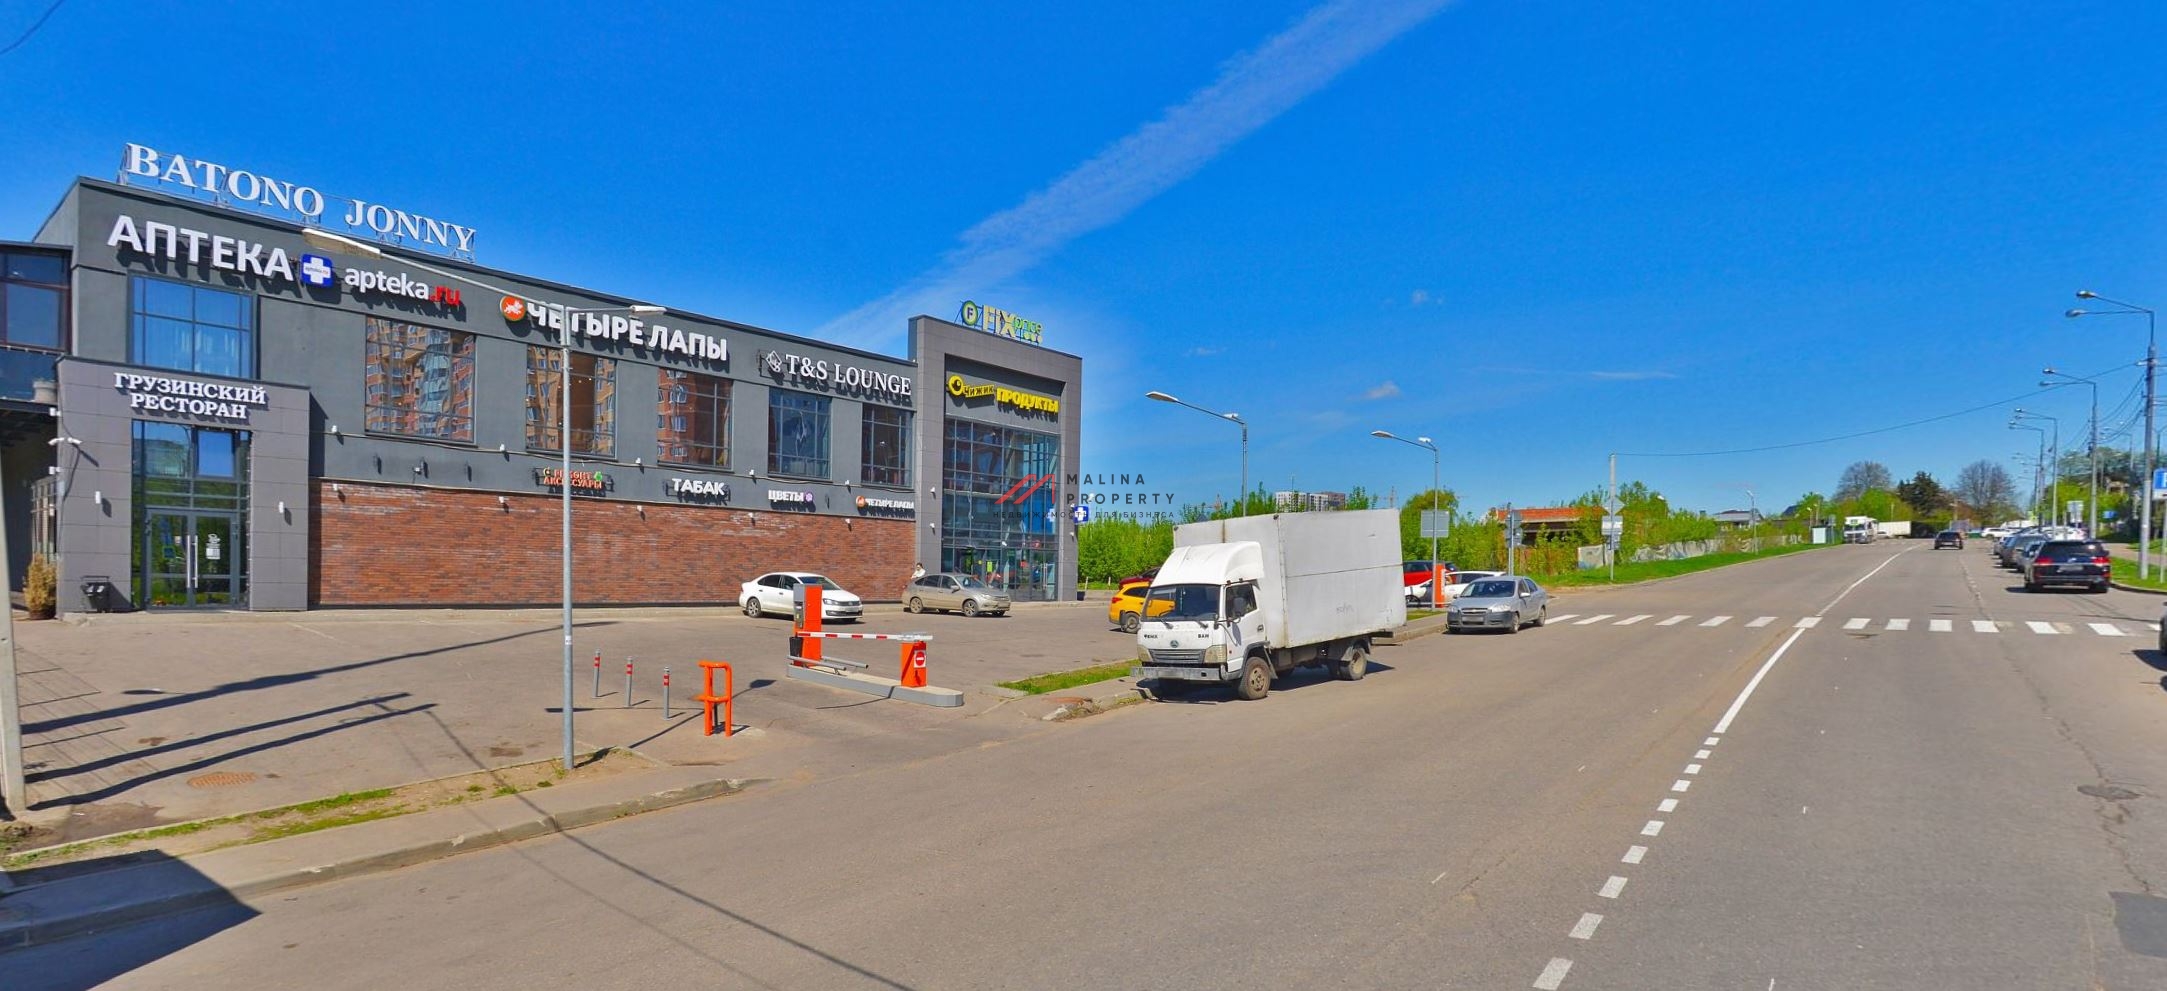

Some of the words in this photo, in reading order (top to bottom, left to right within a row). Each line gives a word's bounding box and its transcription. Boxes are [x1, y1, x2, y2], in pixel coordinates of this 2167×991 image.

[125, 143, 325, 216] BATONO
[344, 199, 478, 252] JONNY
[107, 215, 294, 282] АПТЕКА
[344, 267, 461, 306] apteka.ru
[649, 325, 728, 361] ЛАПЫ
[114, 372, 266, 405] ГРУЗИНСКИЙ
[785, 353, 828, 380] T&S
[834, 363, 912, 395] LOUNGE
[130, 392, 248, 419] РЕСТОРАН
[997, 387, 1059, 413] ПРОДУКТЫ
[543, 476, 602, 489] АКССУАРЫ
[672, 478, 725, 496] ТАБАК
[768, 489, 804, 502] ЦВЕТЫ
